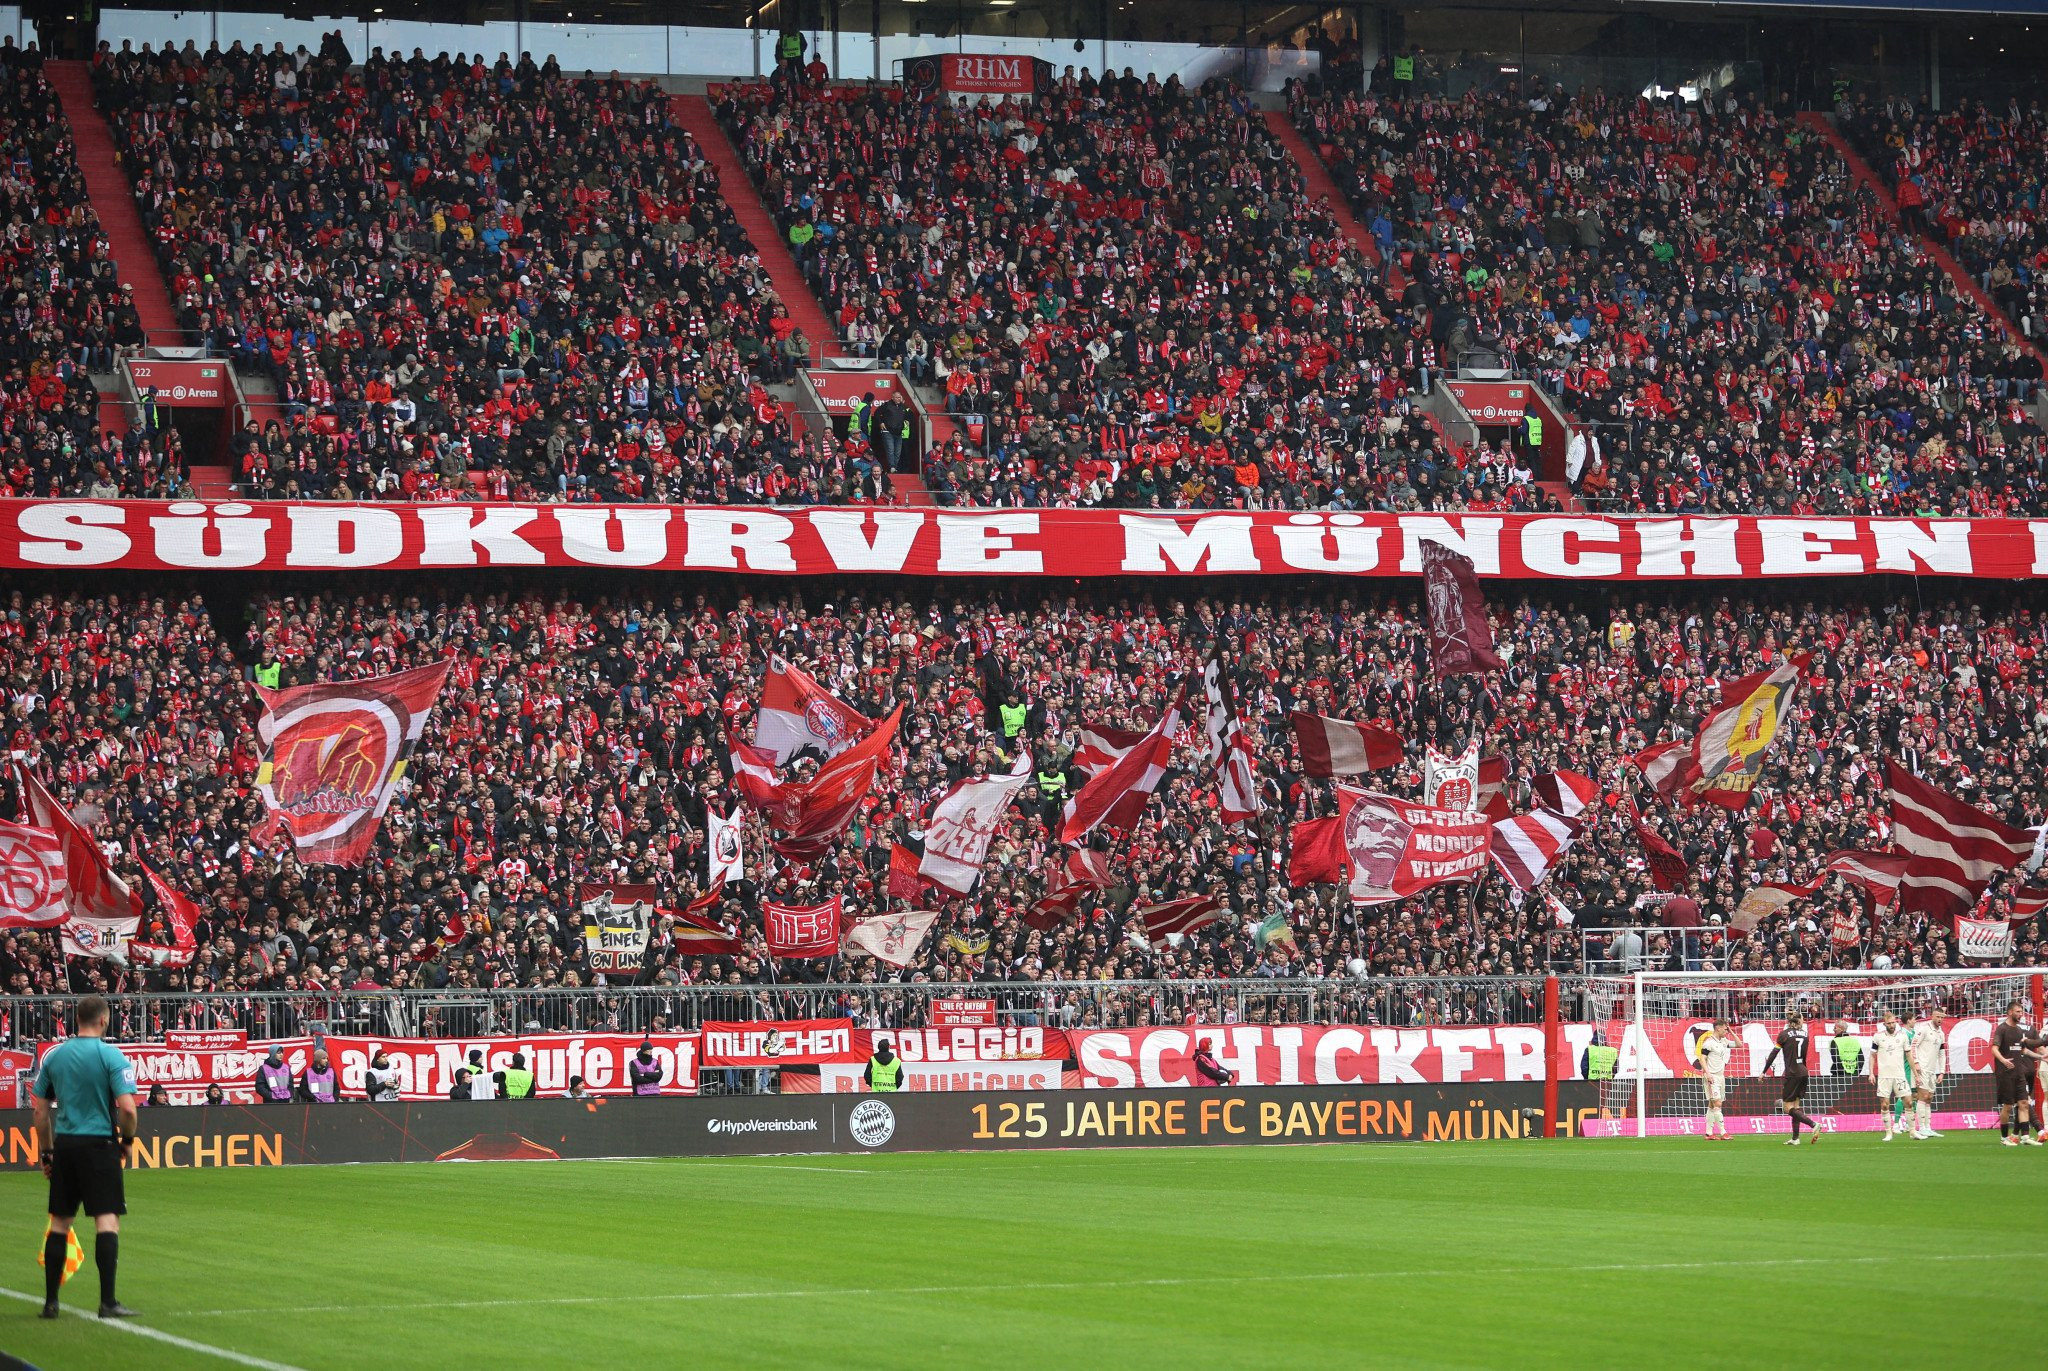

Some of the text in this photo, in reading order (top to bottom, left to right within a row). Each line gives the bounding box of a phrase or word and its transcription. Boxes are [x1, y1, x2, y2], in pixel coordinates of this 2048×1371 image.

[956, 58, 1021, 80] RHM
[135, 368, 151, 377] 222
[813, 379, 826, 387] 221
[188, 387, 218, 398] Arena
[1497, 407, 1523, 417] Arena
[17, 501, 1044, 572] SÜDKURVE
[1119, 513, 1973, 574] MÜNCHEN
[1405, 809, 1488, 828] ULTRAS
[1415, 833, 1485, 854] MODUS
[1410, 851, 1487, 878] VIVENDI
[771, 908, 833, 945] 1158
[599, 932, 643, 948] EINER
[940, 1002, 987, 1011] LOVE FC BAYERN
[945, 1015, 960, 1024] HATE
[1795, 1038, 1804, 1058] 7
[854, 1103, 891, 1120] FC BAYERN
[972, 1102, 1048, 1139] 125
[1061, 1100, 1186, 1137] JAHRE
[1200, 1099, 1246, 1134] FC
[1261, 1100, 1413, 1137] BAYERN
[722, 1118, 818, 1135] HypoVereinsbank
[854, 1127, 891, 1144] MÜNCHEN
[120, 1133, 283, 1168] NCHEN
